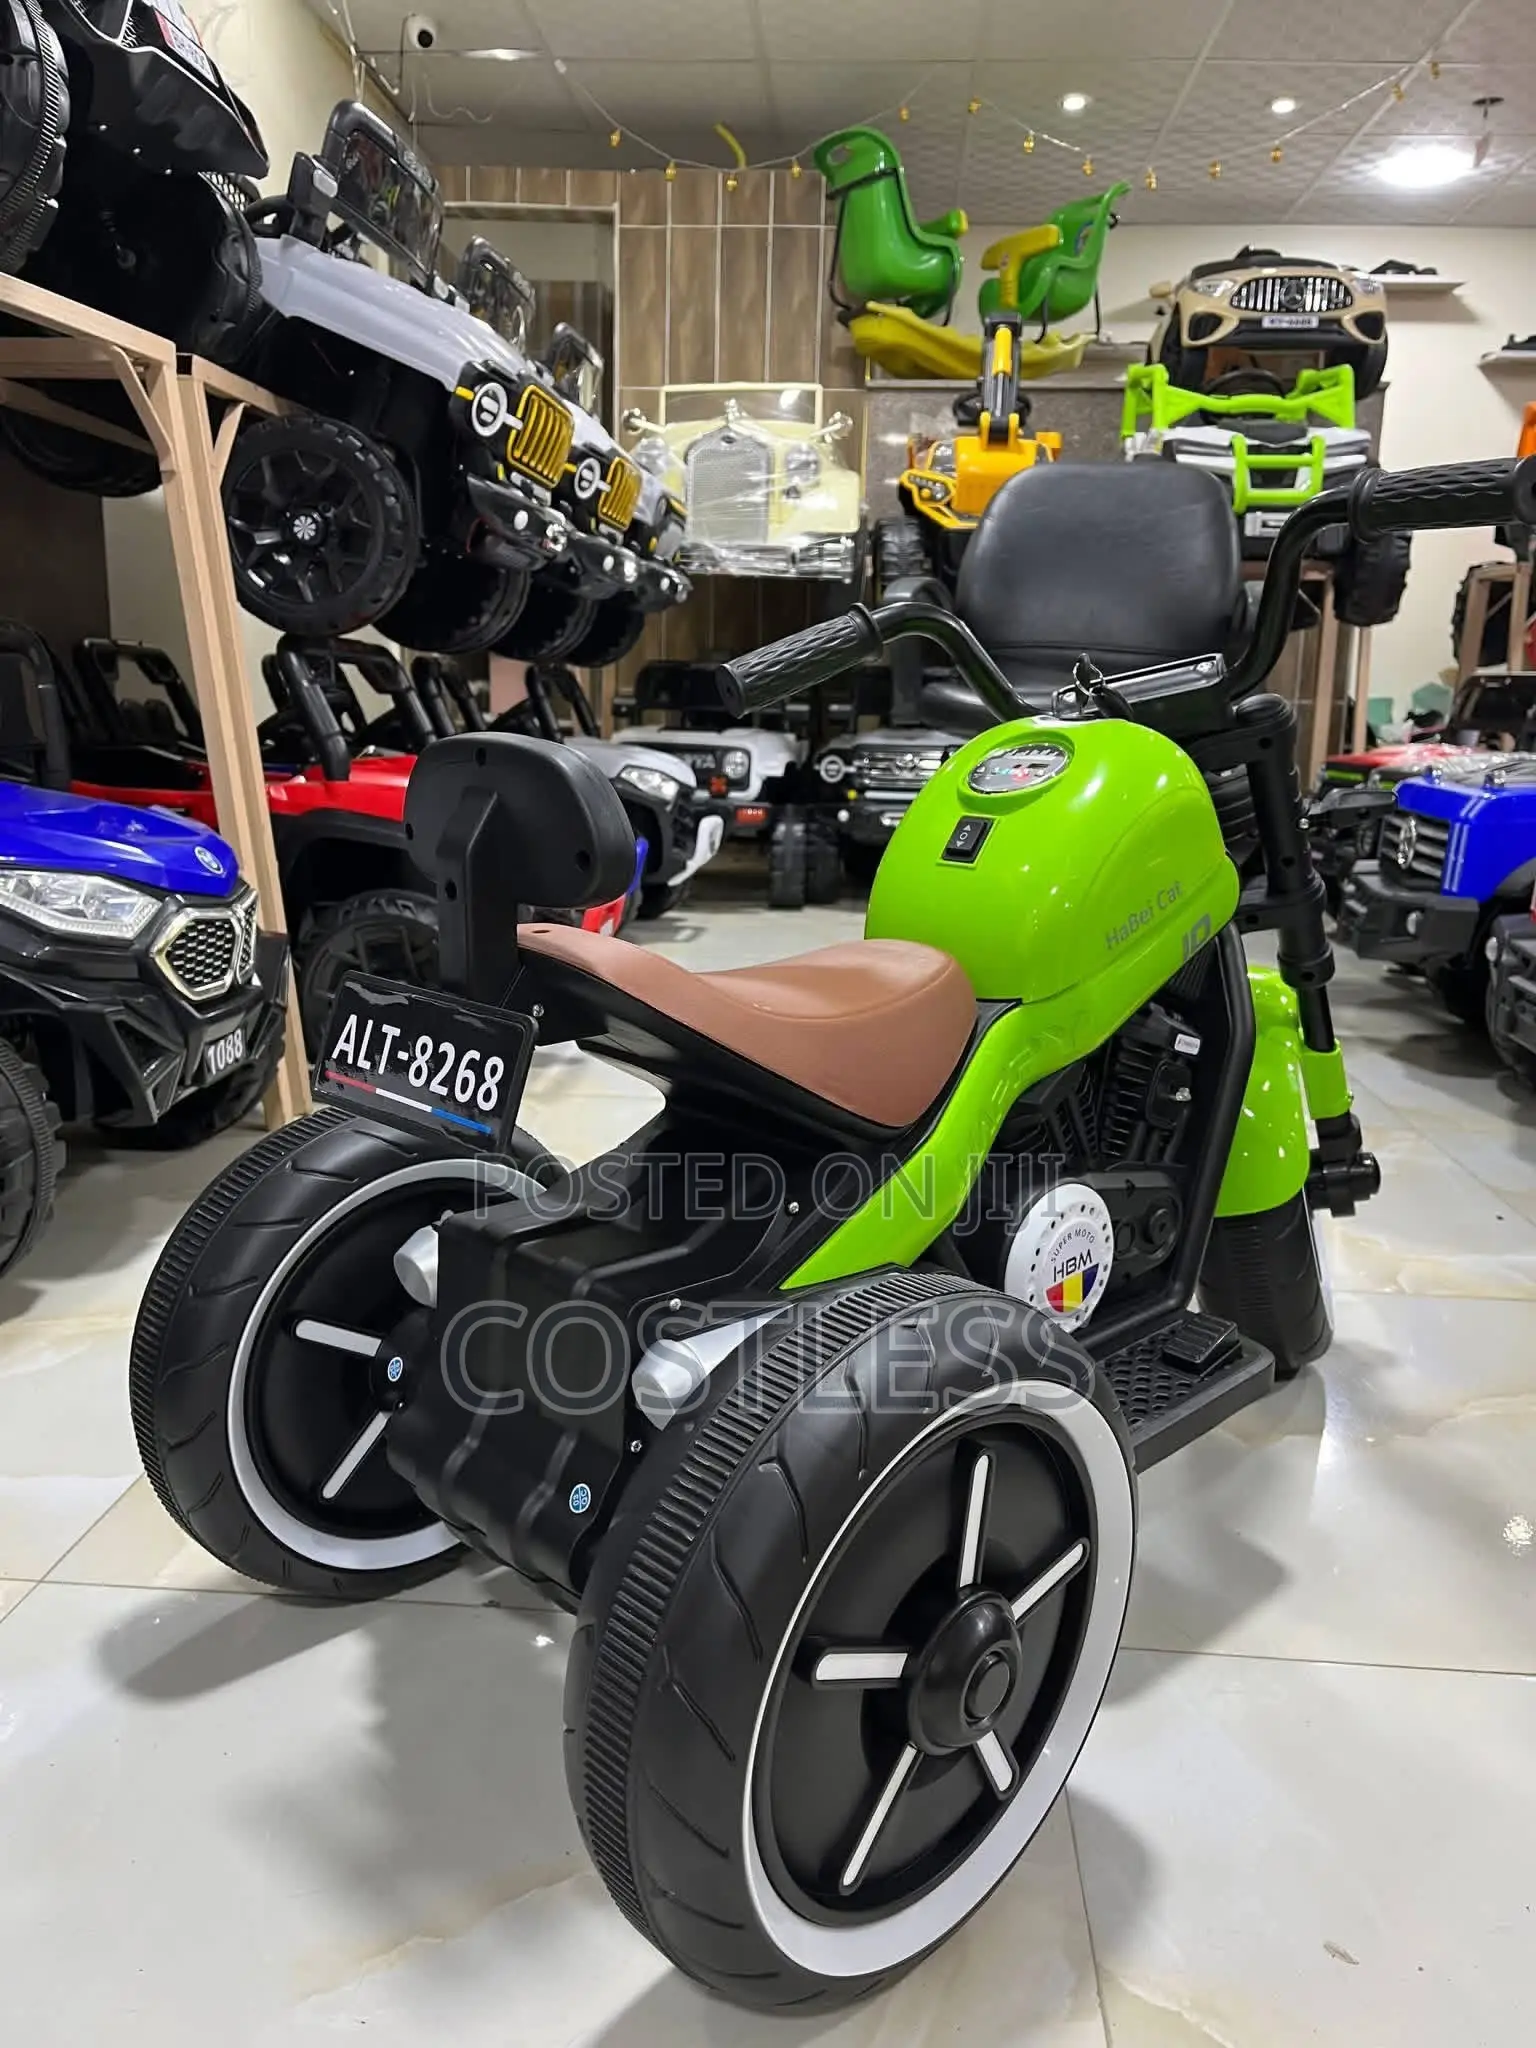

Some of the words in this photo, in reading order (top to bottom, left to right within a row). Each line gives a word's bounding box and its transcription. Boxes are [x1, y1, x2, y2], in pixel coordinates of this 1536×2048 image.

[1106, 900, 1153, 950] HaBei
[1157, 880, 1182, 910] Cat
[207, 1028, 243, 1075] 1088
[331, 1014, 505, 1112] ALT-8268
[1051, 1232, 1073, 1263] SUPER
[1074, 1227, 1095, 1244] MOTO
[1053, 1248, 1093, 1282] HBM
